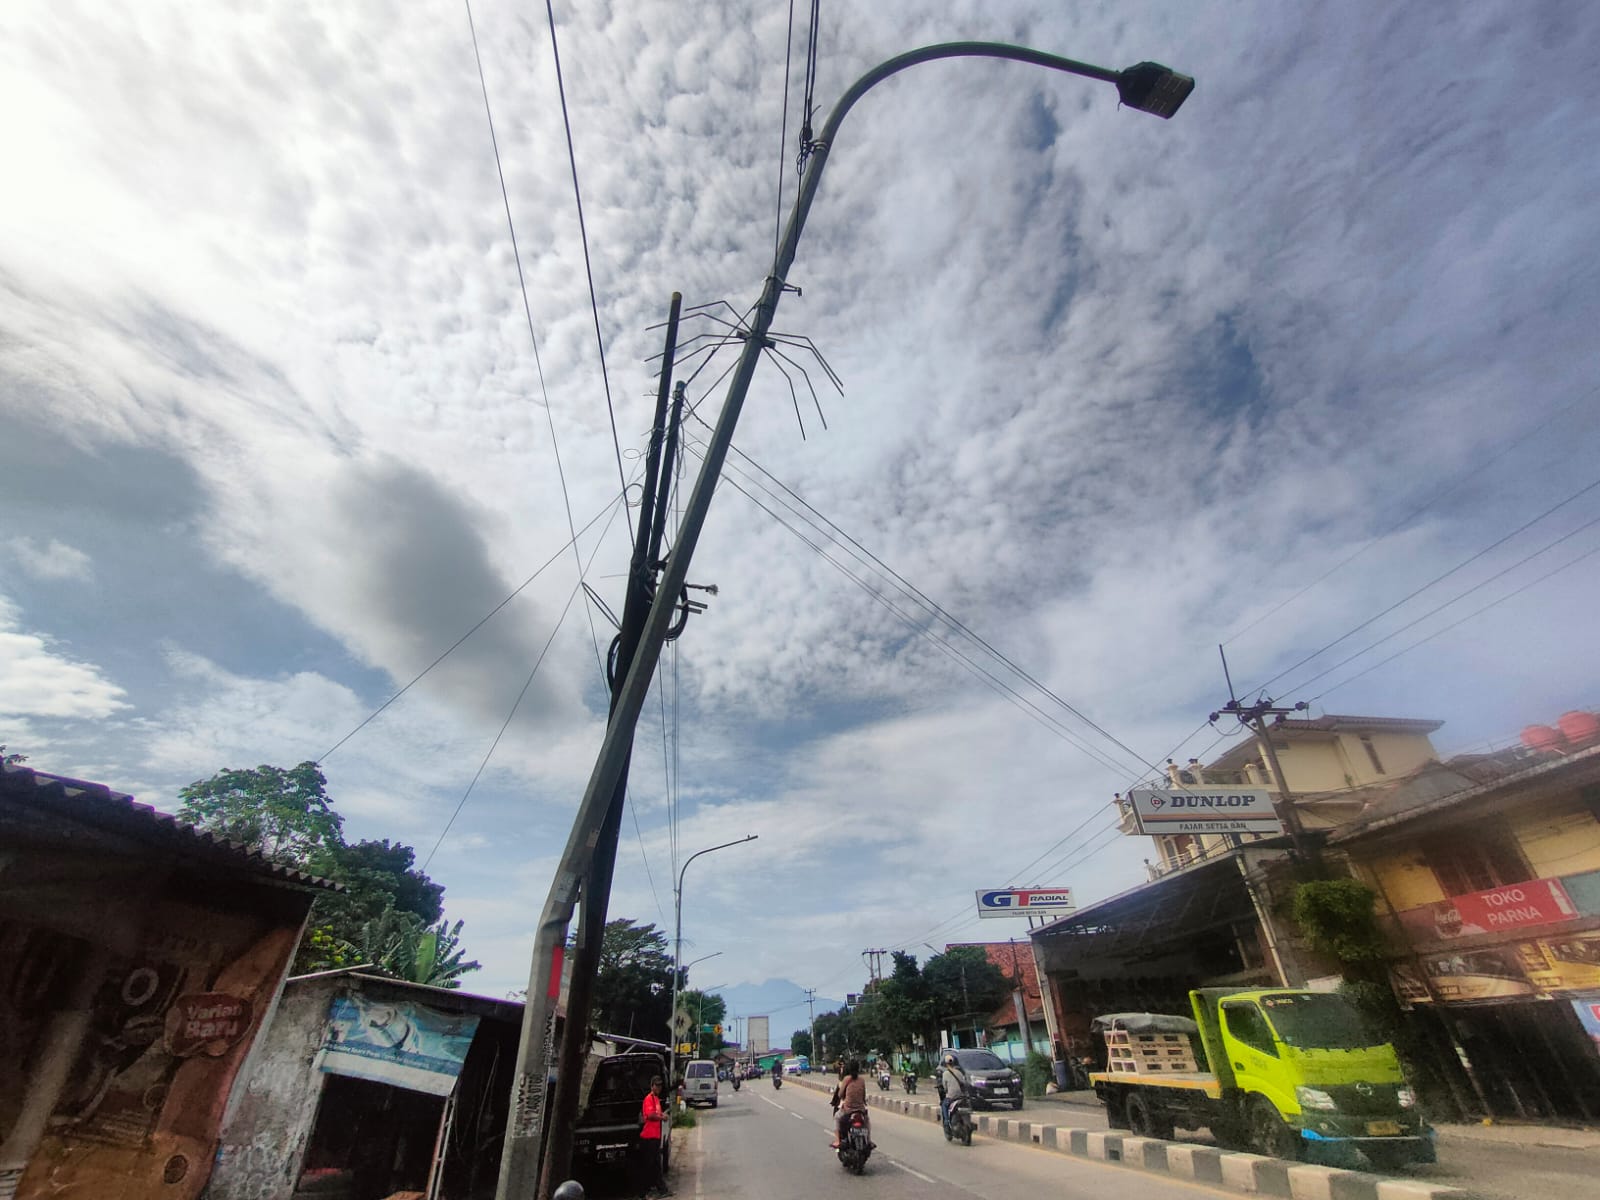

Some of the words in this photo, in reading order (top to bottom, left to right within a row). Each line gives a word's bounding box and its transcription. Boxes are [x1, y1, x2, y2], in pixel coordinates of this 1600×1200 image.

[1170, 795, 1256, 807] DUNLOP
[1179, 823, 1203, 831] FAJAR
[1205, 822, 1229, 830] SETIA
[982, 890, 1030, 907] GT
[1481, 889, 1526, 907] TOKO
[1487, 906, 1543, 926] PARNA
[187, 1003, 243, 1019] Varian
[184, 1020, 239, 1039] Baru
